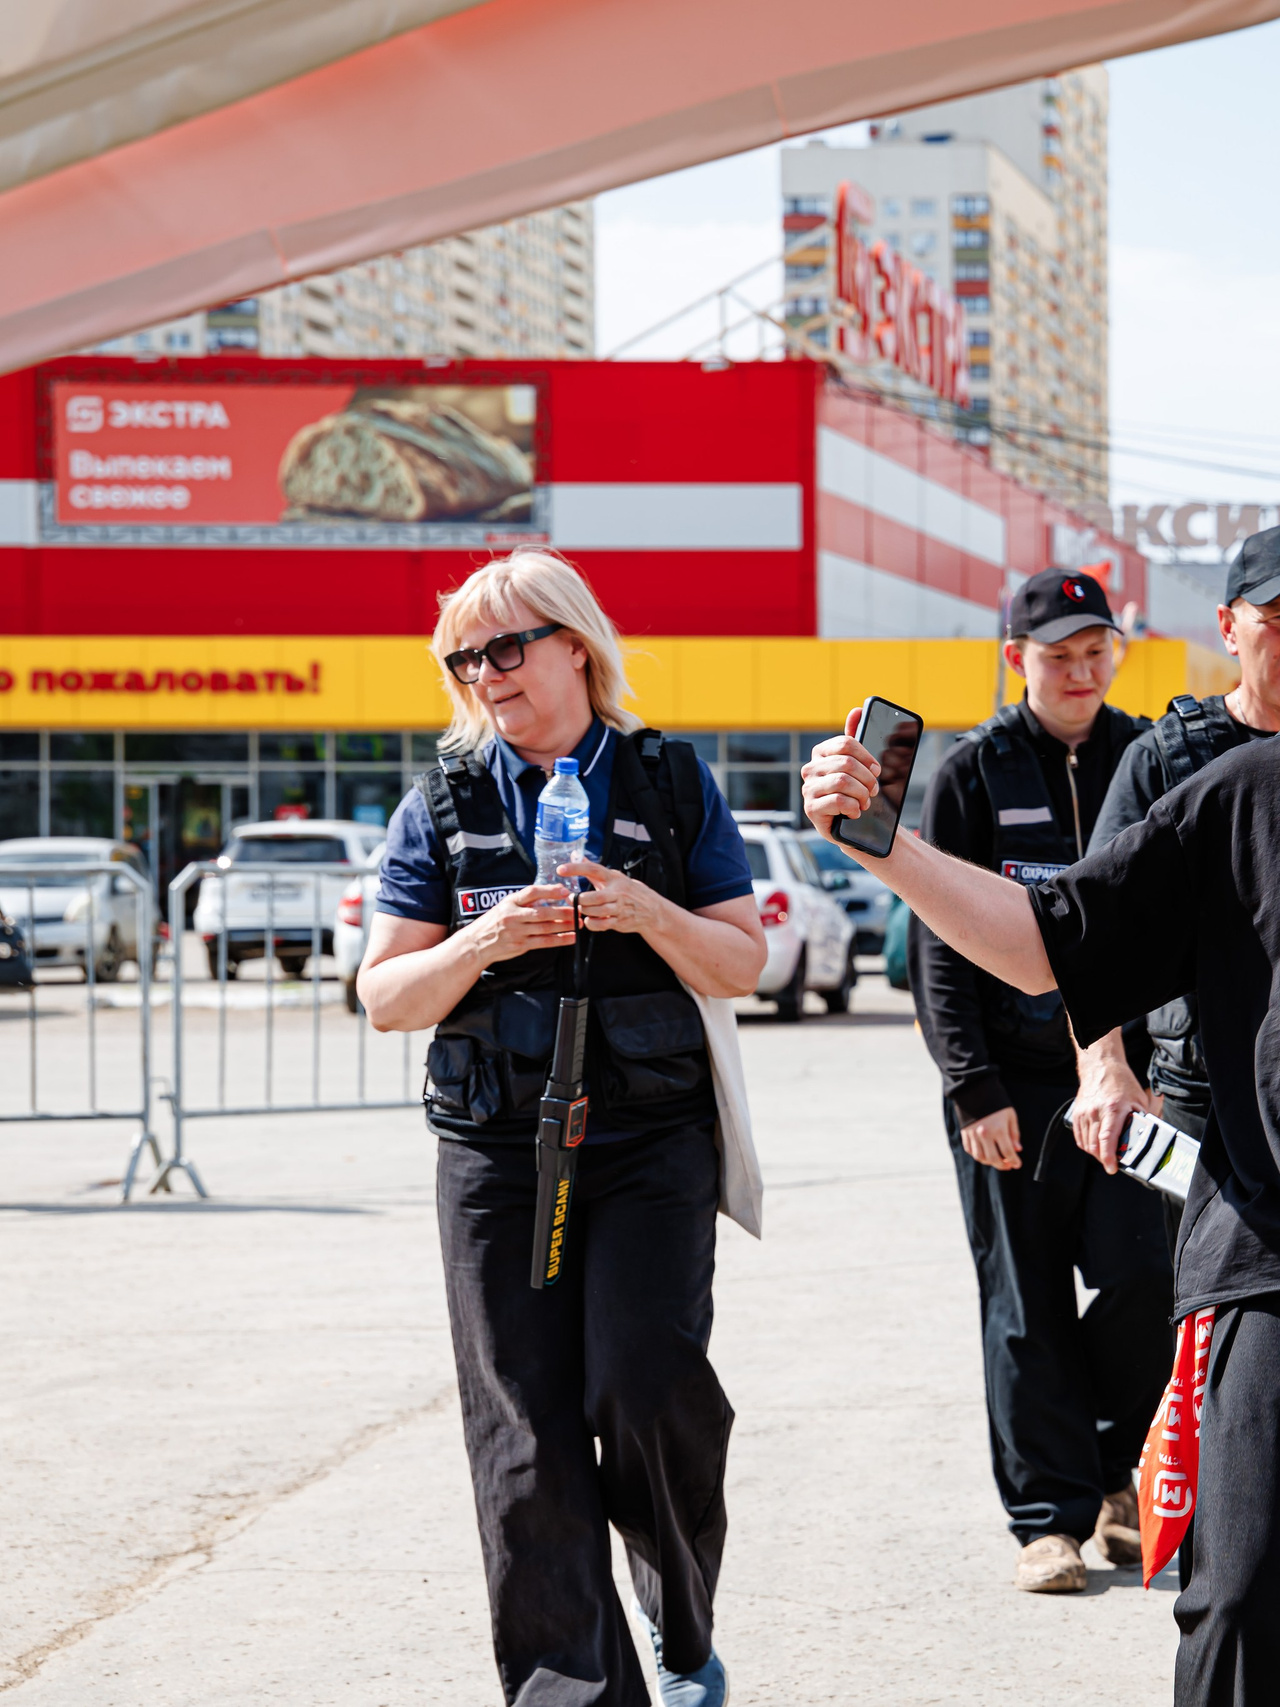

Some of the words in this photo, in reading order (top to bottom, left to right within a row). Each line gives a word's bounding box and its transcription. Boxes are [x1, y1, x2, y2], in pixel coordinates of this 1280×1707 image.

[107, 400, 231, 429] ЭКСТРА
[68, 449, 232, 480] Выпекаем
[68, 484, 191, 510] свежее
[30, 659, 321, 695] пожаловать!
[546, 1227, 564, 1279] SUPER
